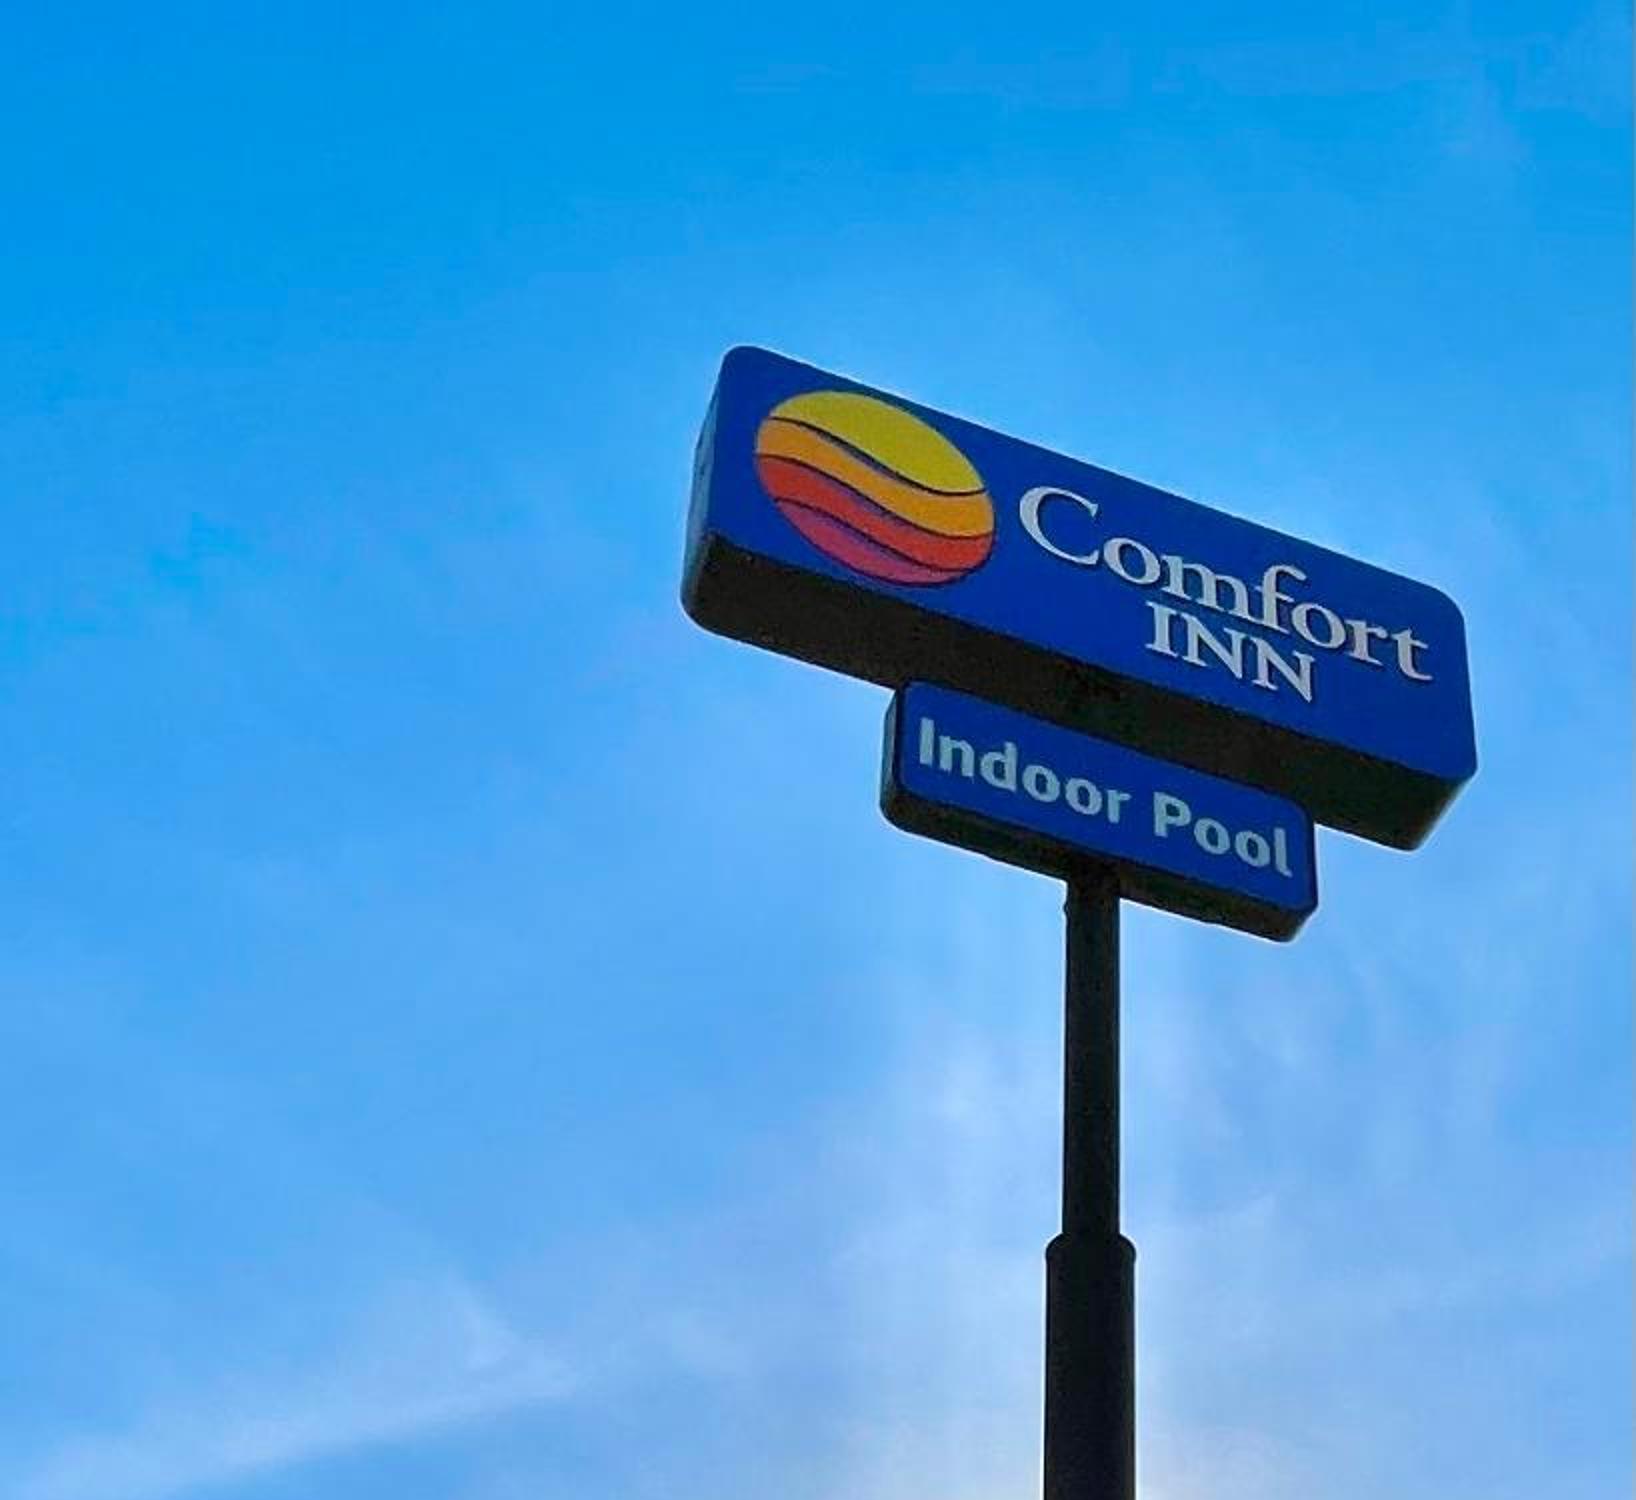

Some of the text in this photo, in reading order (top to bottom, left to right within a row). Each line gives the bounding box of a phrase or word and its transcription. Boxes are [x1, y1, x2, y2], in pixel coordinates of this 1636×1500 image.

[1018, 485, 1433, 682] Comfort
[1146, 600, 1316, 704] INN
[918, 716, 1293, 879] Indoor Pool
